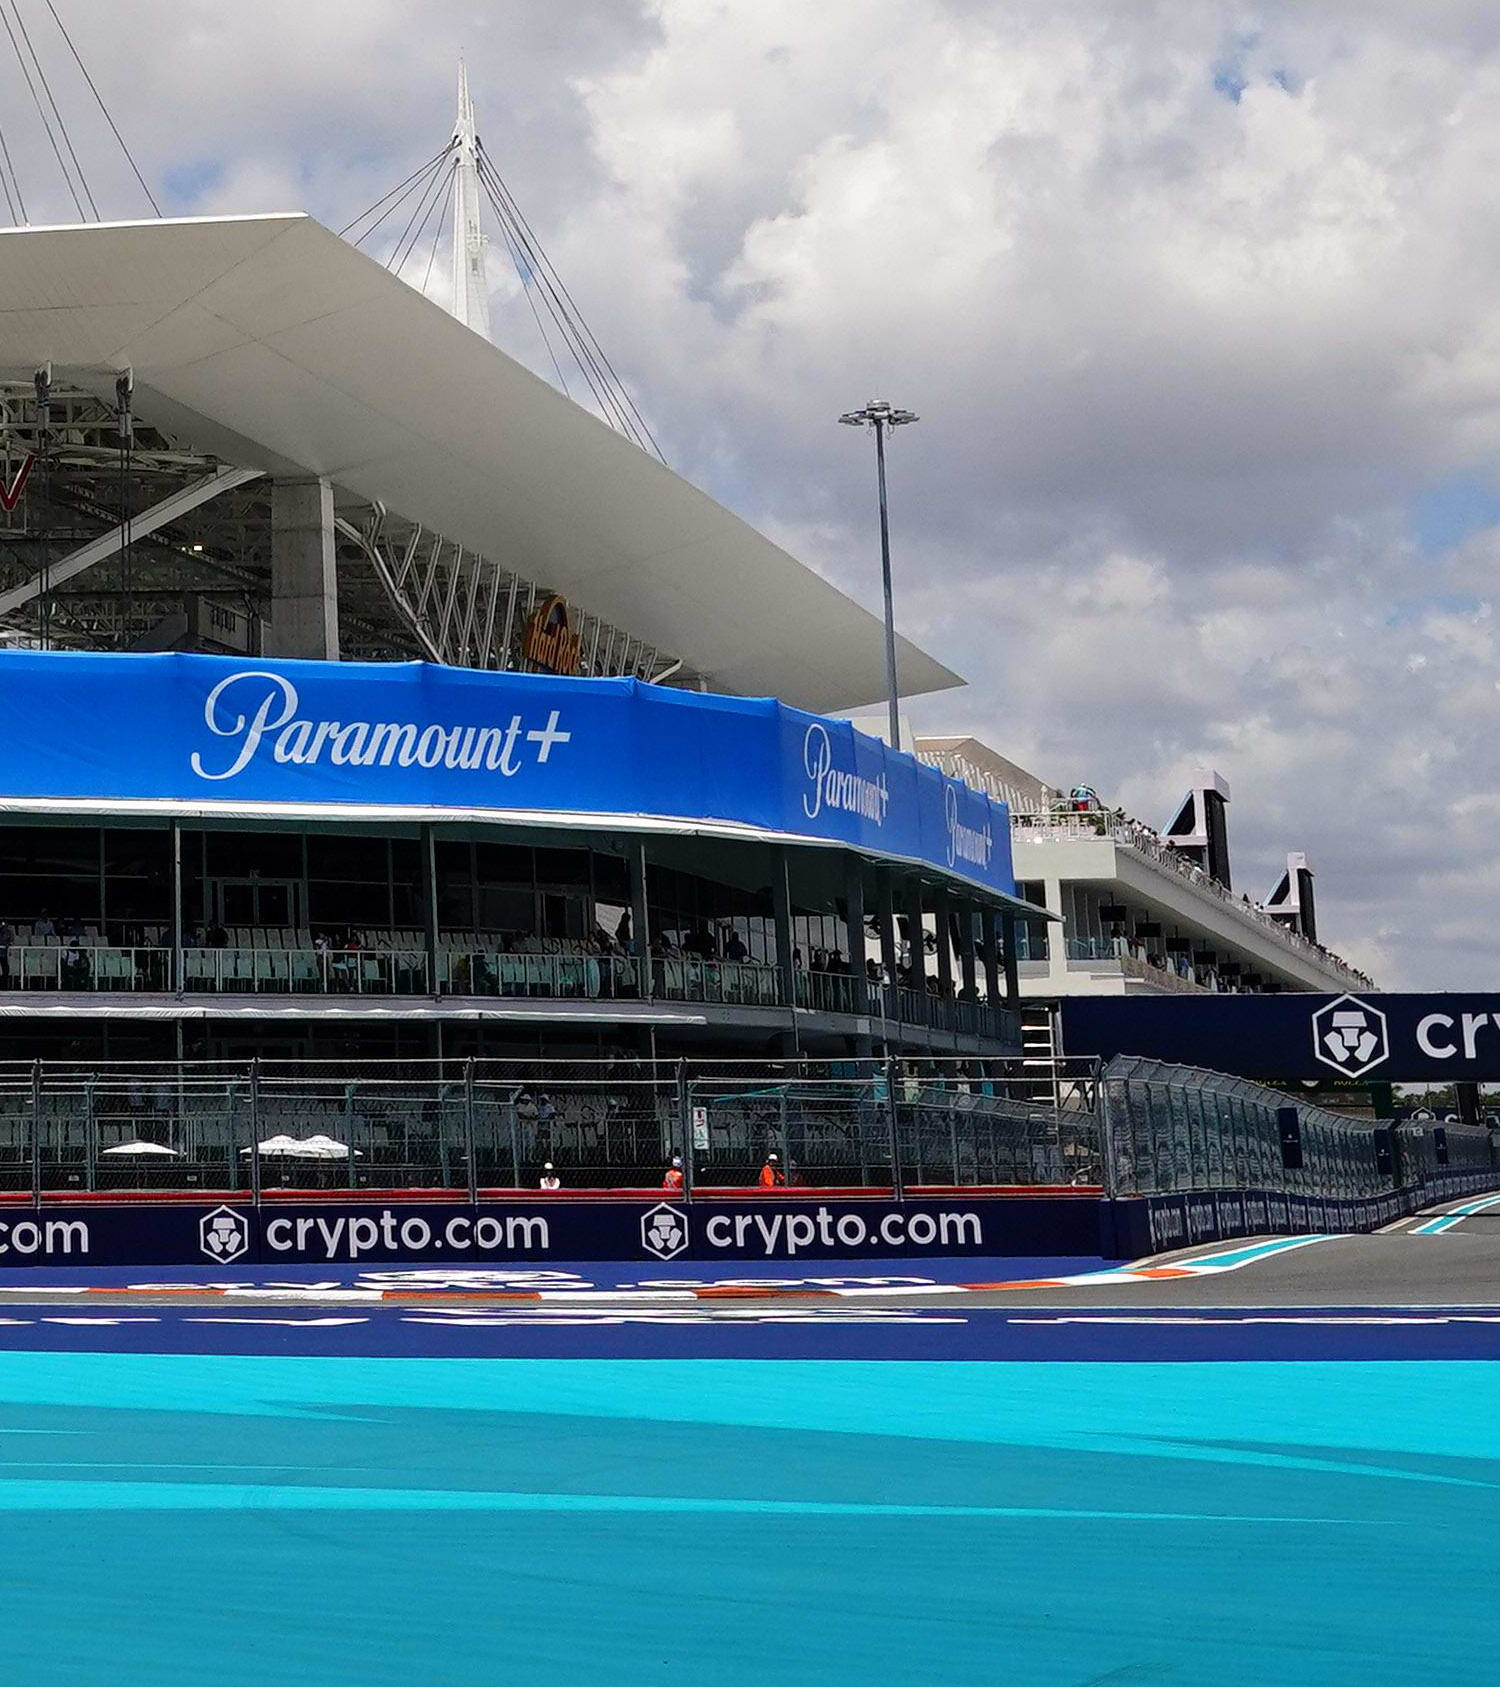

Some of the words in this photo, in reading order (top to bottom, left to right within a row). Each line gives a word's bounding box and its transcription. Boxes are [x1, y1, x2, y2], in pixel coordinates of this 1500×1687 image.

[189, 670, 572, 781] Paramount+
[265, 1209, 551, 1259] crypto.com
[705, 1206, 983, 1256] crypto.com
